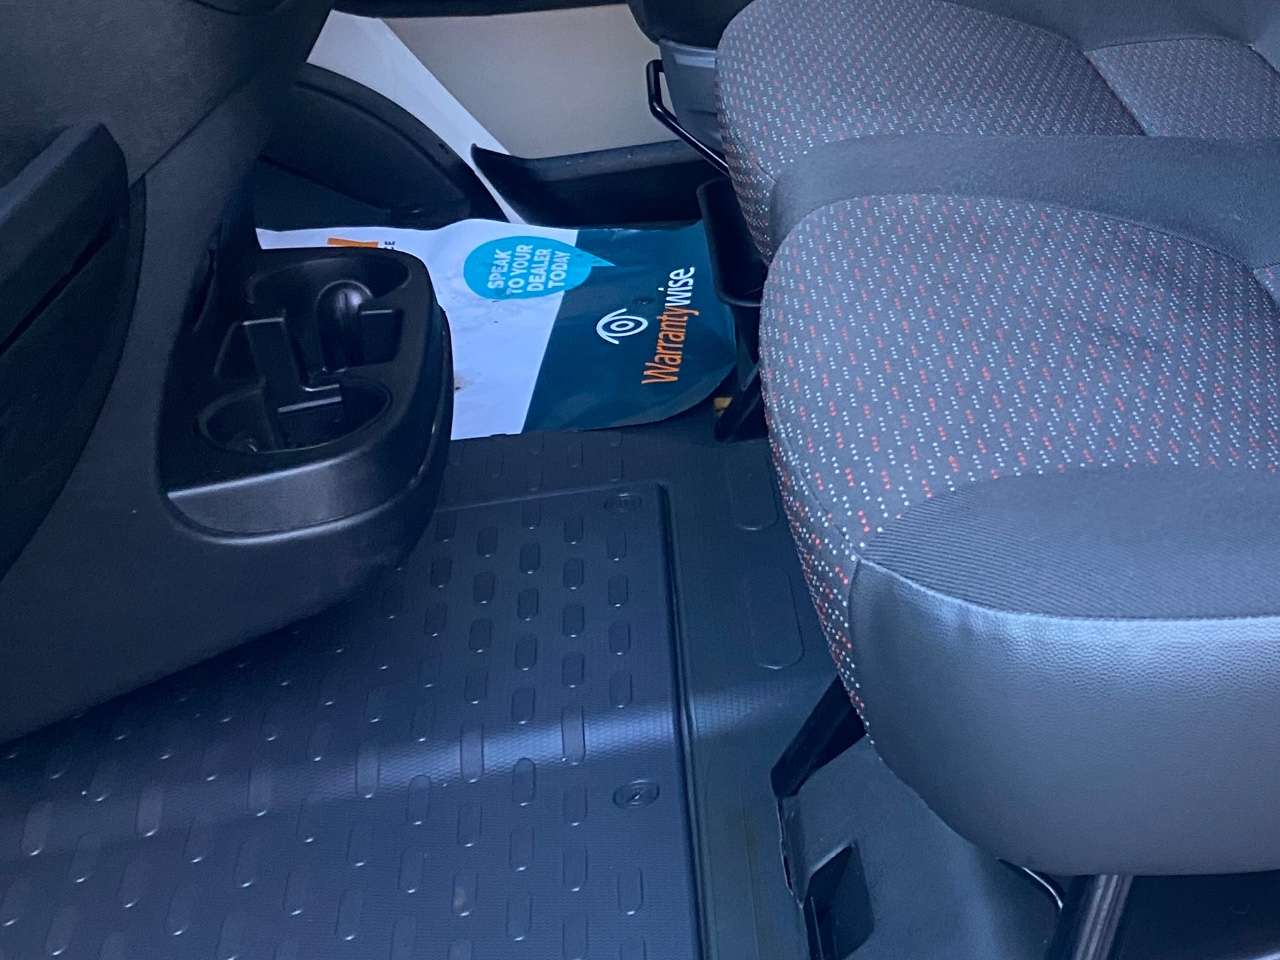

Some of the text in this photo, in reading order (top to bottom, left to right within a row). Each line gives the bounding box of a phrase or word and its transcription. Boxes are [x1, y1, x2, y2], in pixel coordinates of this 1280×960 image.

[487, 248, 513, 289] SPEAK
[506, 244, 534, 295] TO YOUR
[526, 248, 552, 292] DEALER
[547, 250, 571, 288] TODAY
[641, 266, 699, 384] Warrantywise
